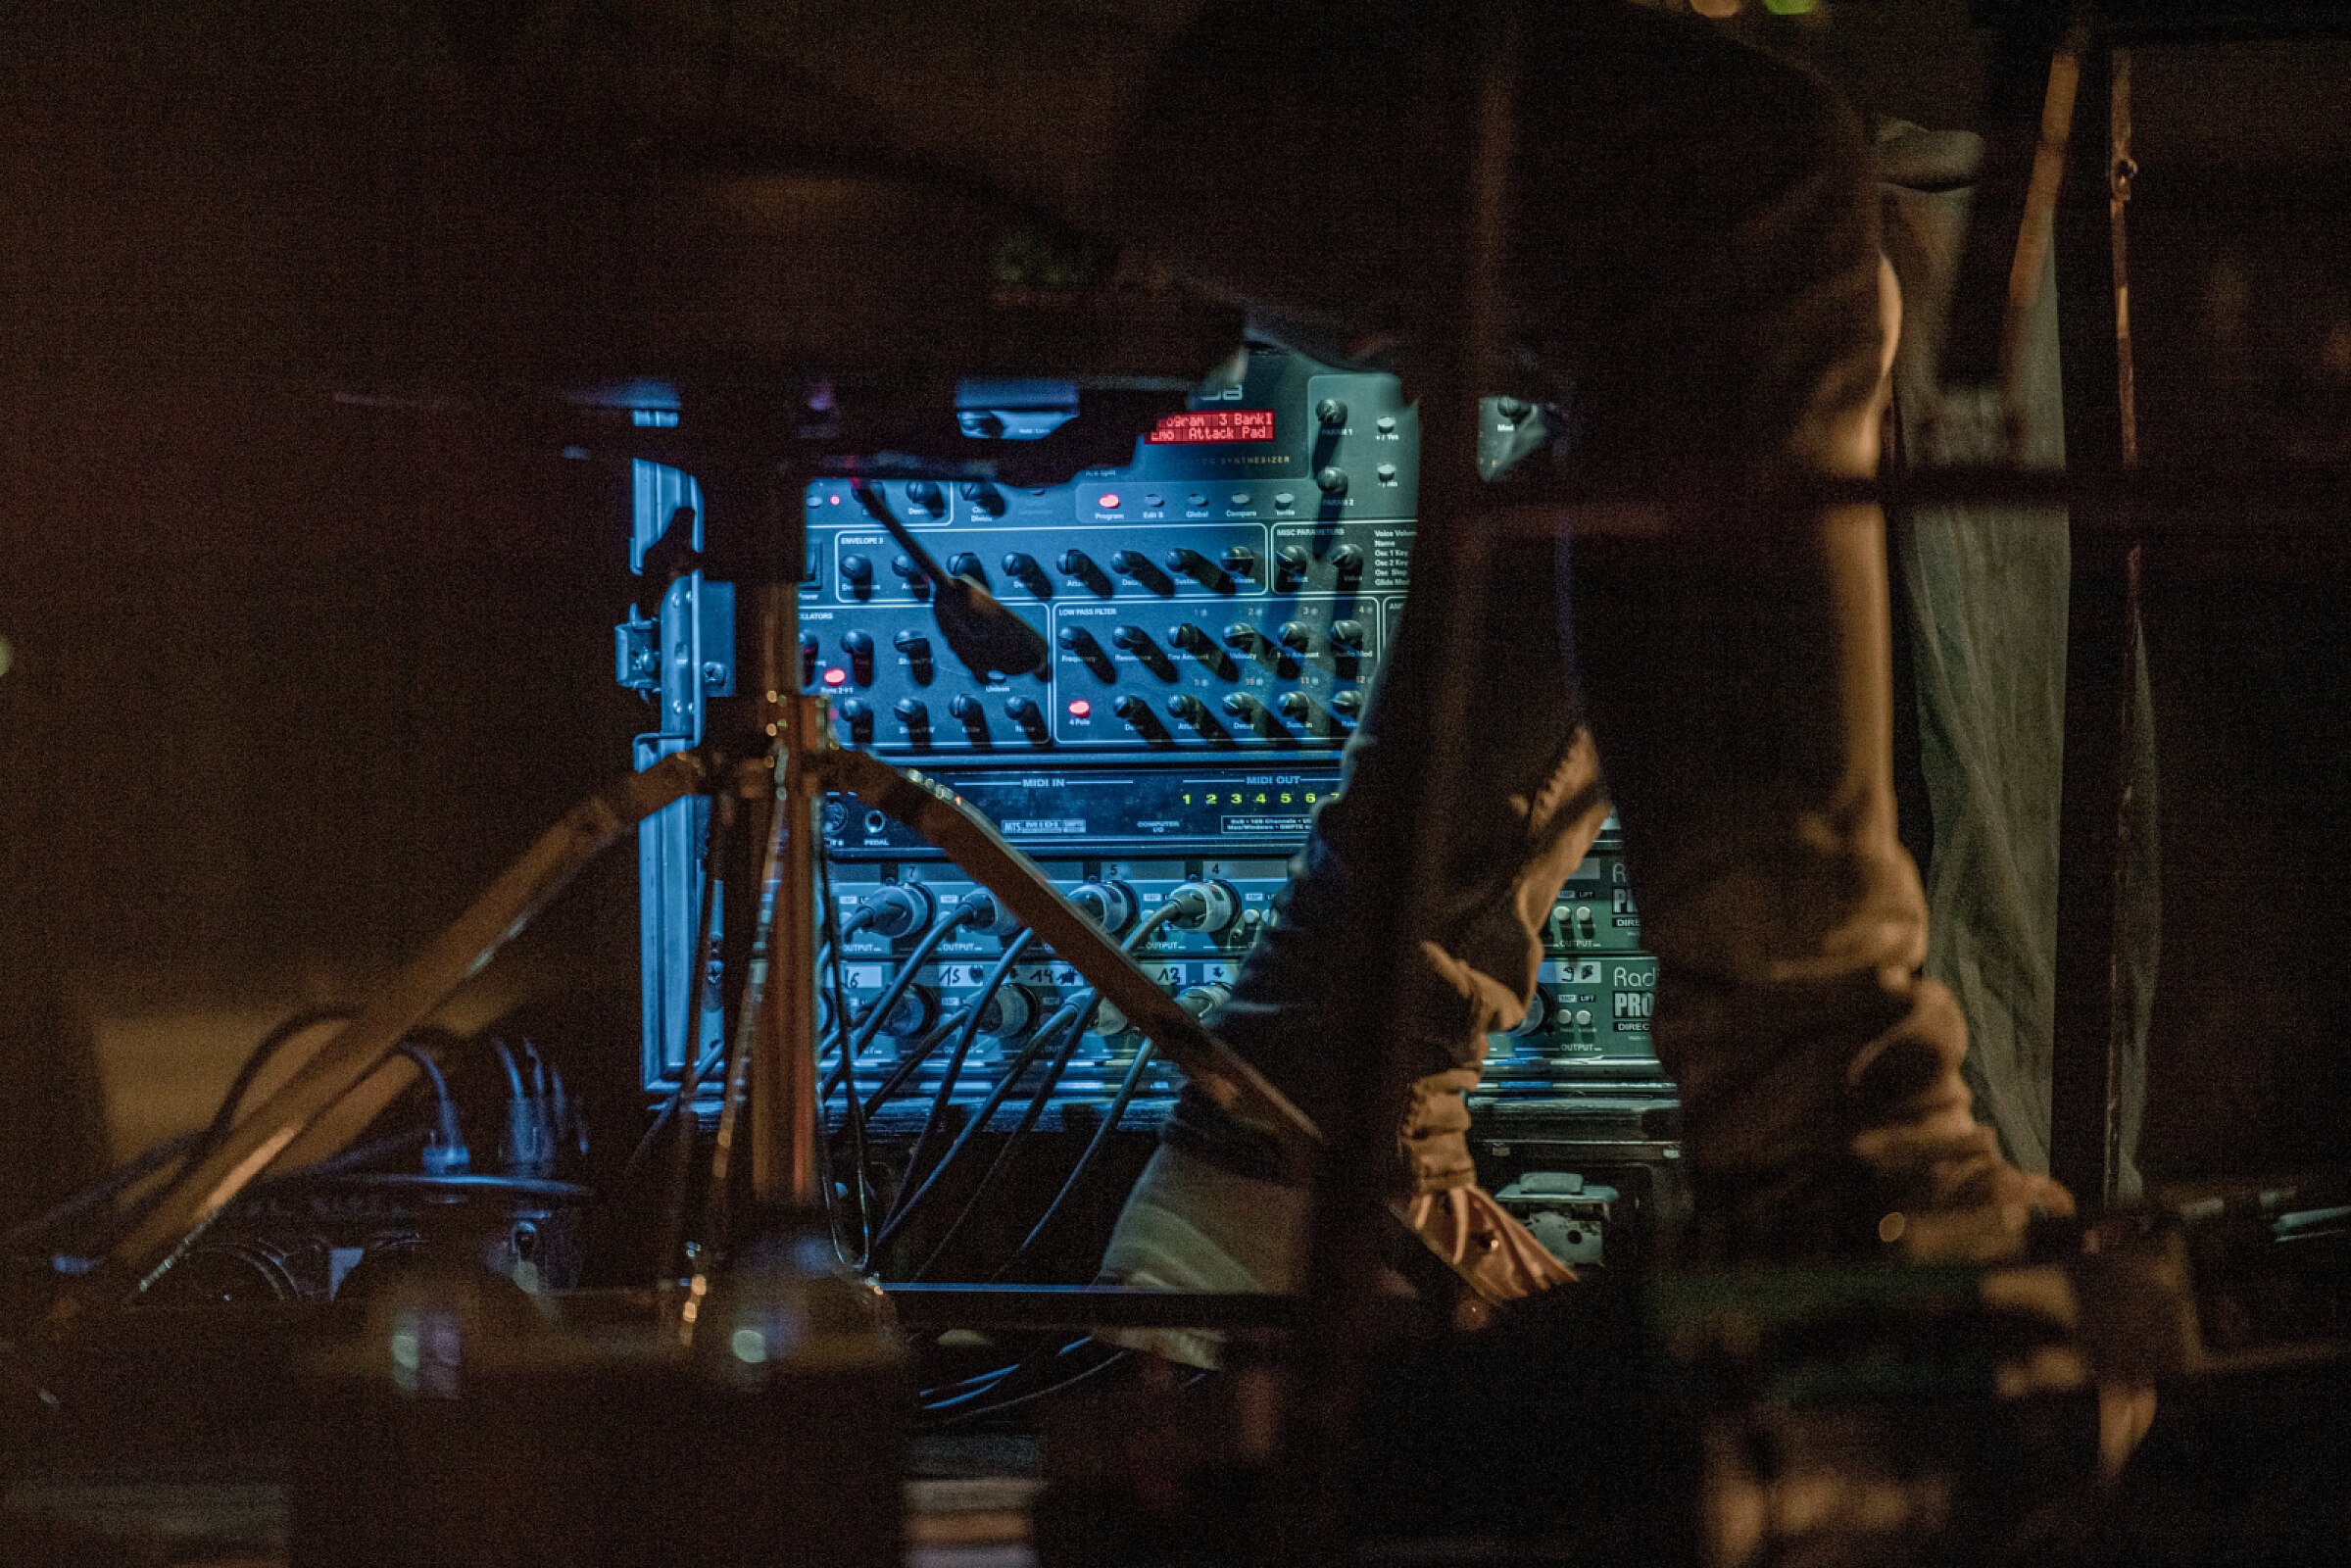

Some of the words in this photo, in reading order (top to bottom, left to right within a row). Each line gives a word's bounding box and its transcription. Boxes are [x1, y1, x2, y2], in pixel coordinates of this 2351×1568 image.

[1158, 416, 1204, 427] ogram
[1219, 413, 1228, 425] 3
[1234, 412, 1273, 425] Bank1
[1189, 427, 1234, 440] Attack
[1242, 426, 1266, 439] Pad
[1247, 776, 1273, 785] MIDI
[1276, 775, 1301, 784] OUT
[1183, 794, 1191, 805] 1
[1206, 794, 1217, 805] 2
[1230, 793, 1243, 804] 3
[1255, 793, 1266, 804] 4
[1280, 793, 1293, 804] 5
[1305, 793, 1316, 804] 6
[908, 866, 916, 878] 7
[1110, 864, 1117, 875] 5
[1211, 863, 1219, 874] 4
[943, 943, 974, 952] OUTPUT
[939, 967, 960, 984] 15
[1030, 969, 1053, 983] 14
[1614, 966, 1656, 987] Rad
